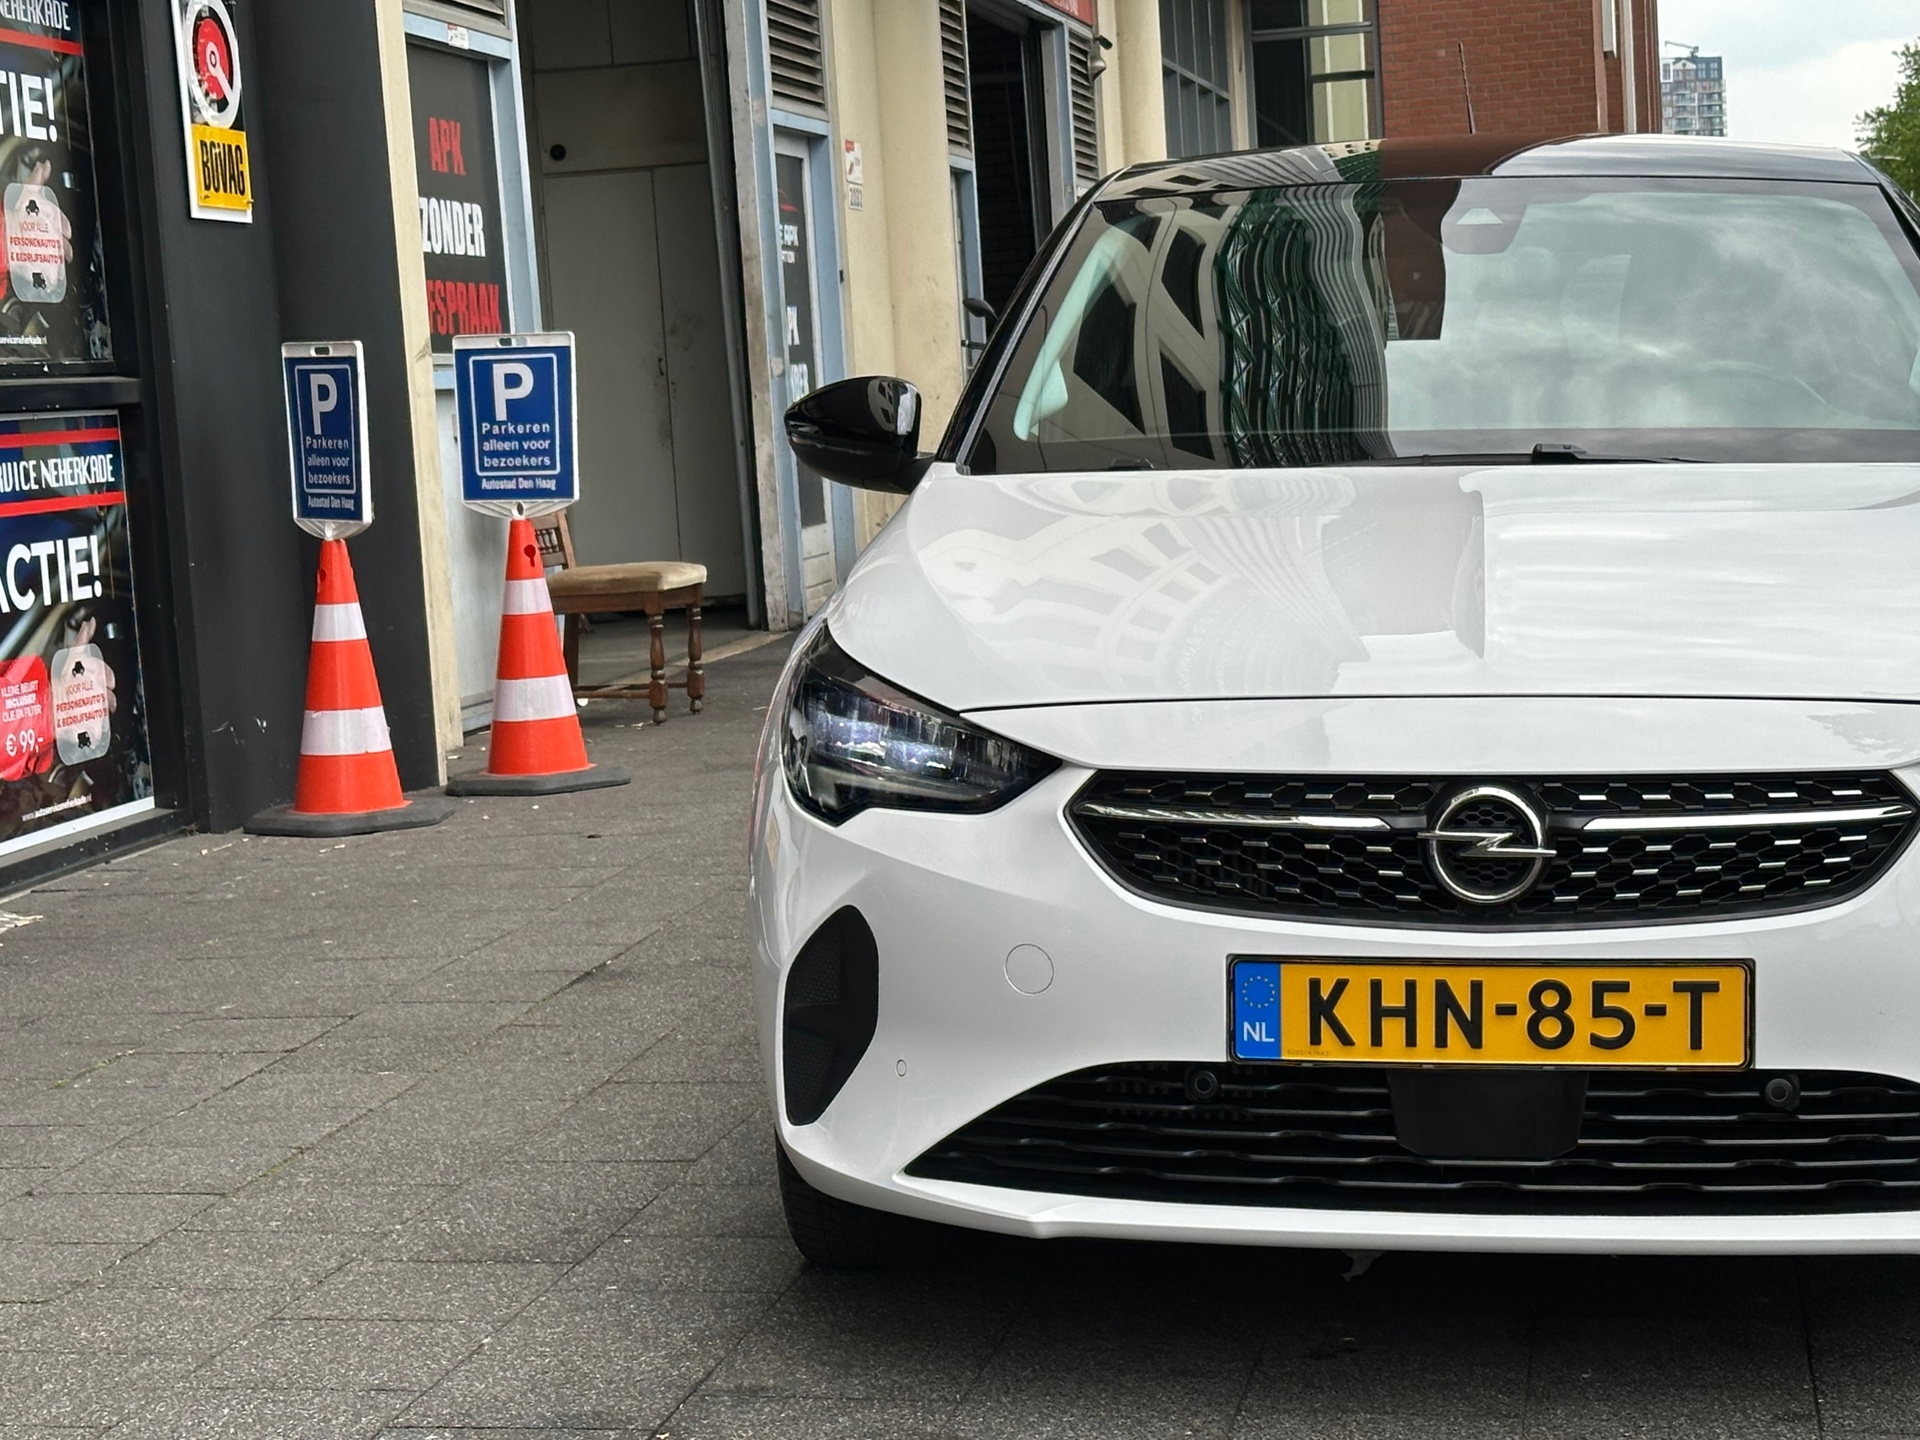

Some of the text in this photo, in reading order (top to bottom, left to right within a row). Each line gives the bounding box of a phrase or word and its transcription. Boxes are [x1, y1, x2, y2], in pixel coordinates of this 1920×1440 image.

[429, 117, 466, 175] APK
[200, 139, 245, 196] BOVAG
[419, 197, 486, 257] ZONDER
[427, 279, 502, 336] FSPRAAK
[493, 363, 534, 421] P
[310, 374, 338, 435] P
[482, 422, 550, 435] Parkeren
[306, 436, 349, 449] Parkeren
[483, 439, 551, 451] alleen voor
[307, 455, 350, 467] alleen voor
[484, 455, 551, 468] bezoekers
[40, 454, 115, 489] NEHERKADE
[308, 472, 350, 484] bezoekers
[482, 478, 556, 491] Autostad Den Haag
[308, 496, 354, 511] Autostad Den Haag
[0, 534, 102, 614] CTIE!
[65, 680, 93, 695] VOOR ALLE
[56, 693, 106, 713] PERSONENAUTO'S
[56, 718, 61, 728] &
[6, 728, 44, 757] € 99,-
[1308, 977, 1720, 1051] KHN-85-T
[1243, 1021, 1275, 1042] NL
